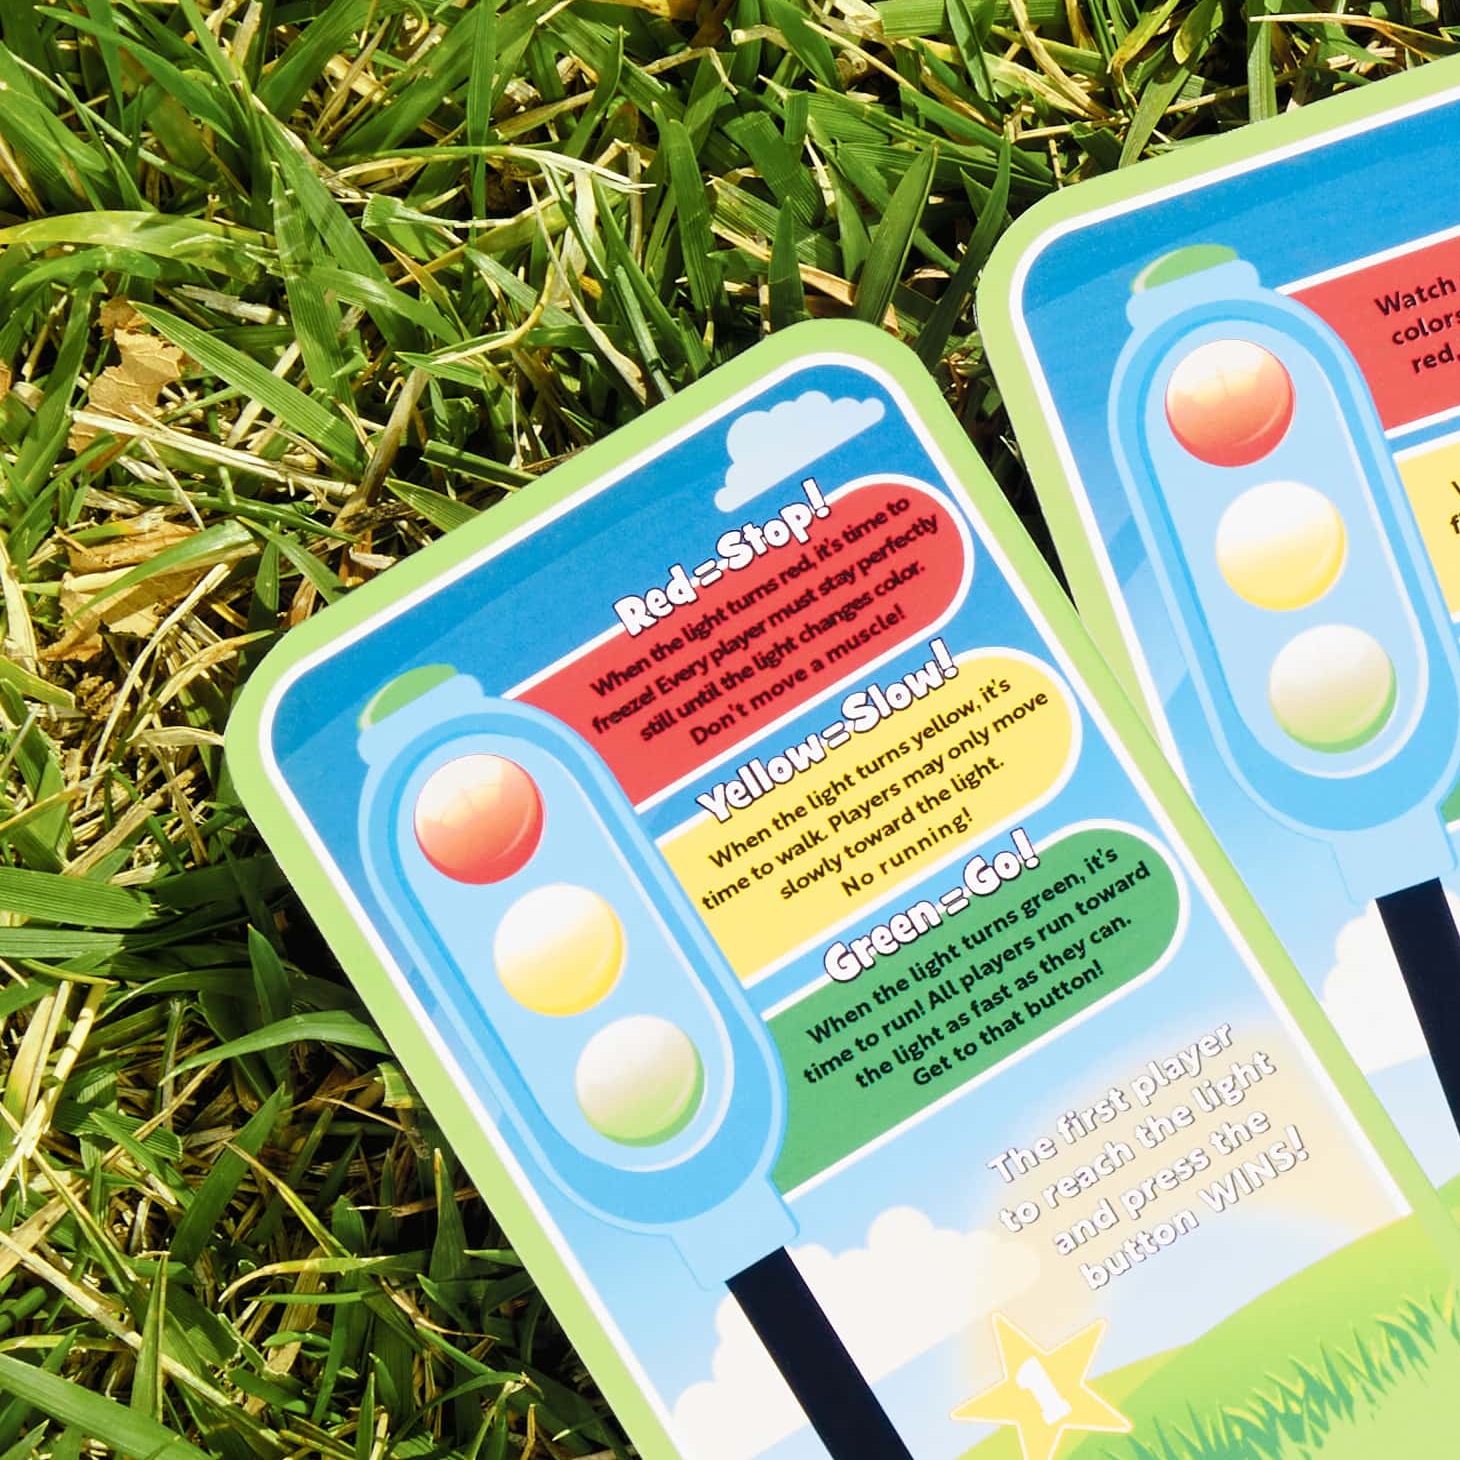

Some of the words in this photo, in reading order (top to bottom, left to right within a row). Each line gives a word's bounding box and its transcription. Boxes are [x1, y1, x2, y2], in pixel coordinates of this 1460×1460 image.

[1375, 277, 1456, 315] Watch
[1412, 343, 1460, 373] red,
[591, 658, 651, 696] When
[650, 638, 684, 661] the
[682, 608, 728, 642] light
[727, 579, 779, 614] turns
[779, 554, 816, 584] red,
[814, 539, 843, 561] it's
[842, 512, 888, 543] time
[887, 499, 909, 516] to
[593, 686, 656, 733] freeze!
[656, 656, 708, 695] Every
[710, 620, 765, 666] player
[768, 589, 818, 627] must
[819, 566, 855, 596] stay
[857, 515, 937, 576] perfectly
[641, 710, 677, 740] still
[677, 682, 722, 718] until
[720, 666, 754, 690] the
[752, 637, 798, 670] light
[800, 592, 874, 642] changes
[875, 562, 925, 596] color.
[690, 704, 748, 745] Don't
[750, 670, 807, 710] move
[811, 659, 824, 672] a
[826, 604, 904, 663] muscle!
[703, 877, 750, 909] time
[751, 863, 773, 880] to
[776, 831, 828, 865] walk.
[828, 784, 901, 832] Players
[903, 755, 944, 788] may
[948, 727, 989, 759] only
[992, 694, 1048, 732] move
[709, 828, 771, 867] When
[772, 806, 808, 830] the
[807, 774, 856, 809] light
[856, 742, 910, 778] turns
[911, 700, 981, 751] yellow,
[980, 679, 1010, 703] it's
[781, 854, 841, 899] slowly
[844, 806, 916, 858] toward
[916, 789, 951, 813] the
[950, 757, 1004, 792] light.
[841, 873, 873, 896] No
[880, 807, 972, 874] running!
[804, 1049, 854, 1083] time
[855, 1033, 879, 1052] to
[882, 1000, 925, 1037] run!
[929, 980, 959, 1010] All
[960, 936, 1035, 993] players
[1037, 913, 1074, 941] run
[1075, 861, 1150, 915] toward
[806, 1002, 872, 1043] When
[873, 979, 909, 1004] the
[909, 945, 960, 982] light
[962, 911, 1018, 949] turns
[1021, 874, 1085, 919] green,
[1084, 849, 1118, 874] it's
[856, 1061, 893, 1087] the
[892, 1027, 944, 1064] light
[946, 1013, 970, 1033] as
[971, 985, 1012, 1017] fast
[1015, 970, 1038, 990] as
[1040, 939, 1085, 973] they
[1090, 917, 1131, 944] can.
[913, 1056, 952, 1085] Get
[953, 1043, 977, 1061] to
[980, 1011, 1024, 1045] that
[1024, 959, 1103, 1017] button!
[987, 1139, 1058, 1183] The
[1058, 1088, 1131, 1144] first
[1132, 1024, 1232, 1107] player
[999, 1203, 1040, 1232] to
[1042, 1142, 1136, 1209] reach
[1136, 1107, 1195, 1148] the
[1195, 1052, 1277, 1112] light
[1054, 1198, 1120, 1255] and
[1122, 1148, 1211, 1220] press
[1212, 1113, 1271, 1155] the
[1080, 1211, 1199, 1290] button
[1198, 1125, 1309, 1212] WINS!
[1016, 1355, 1072, 1425] 1
